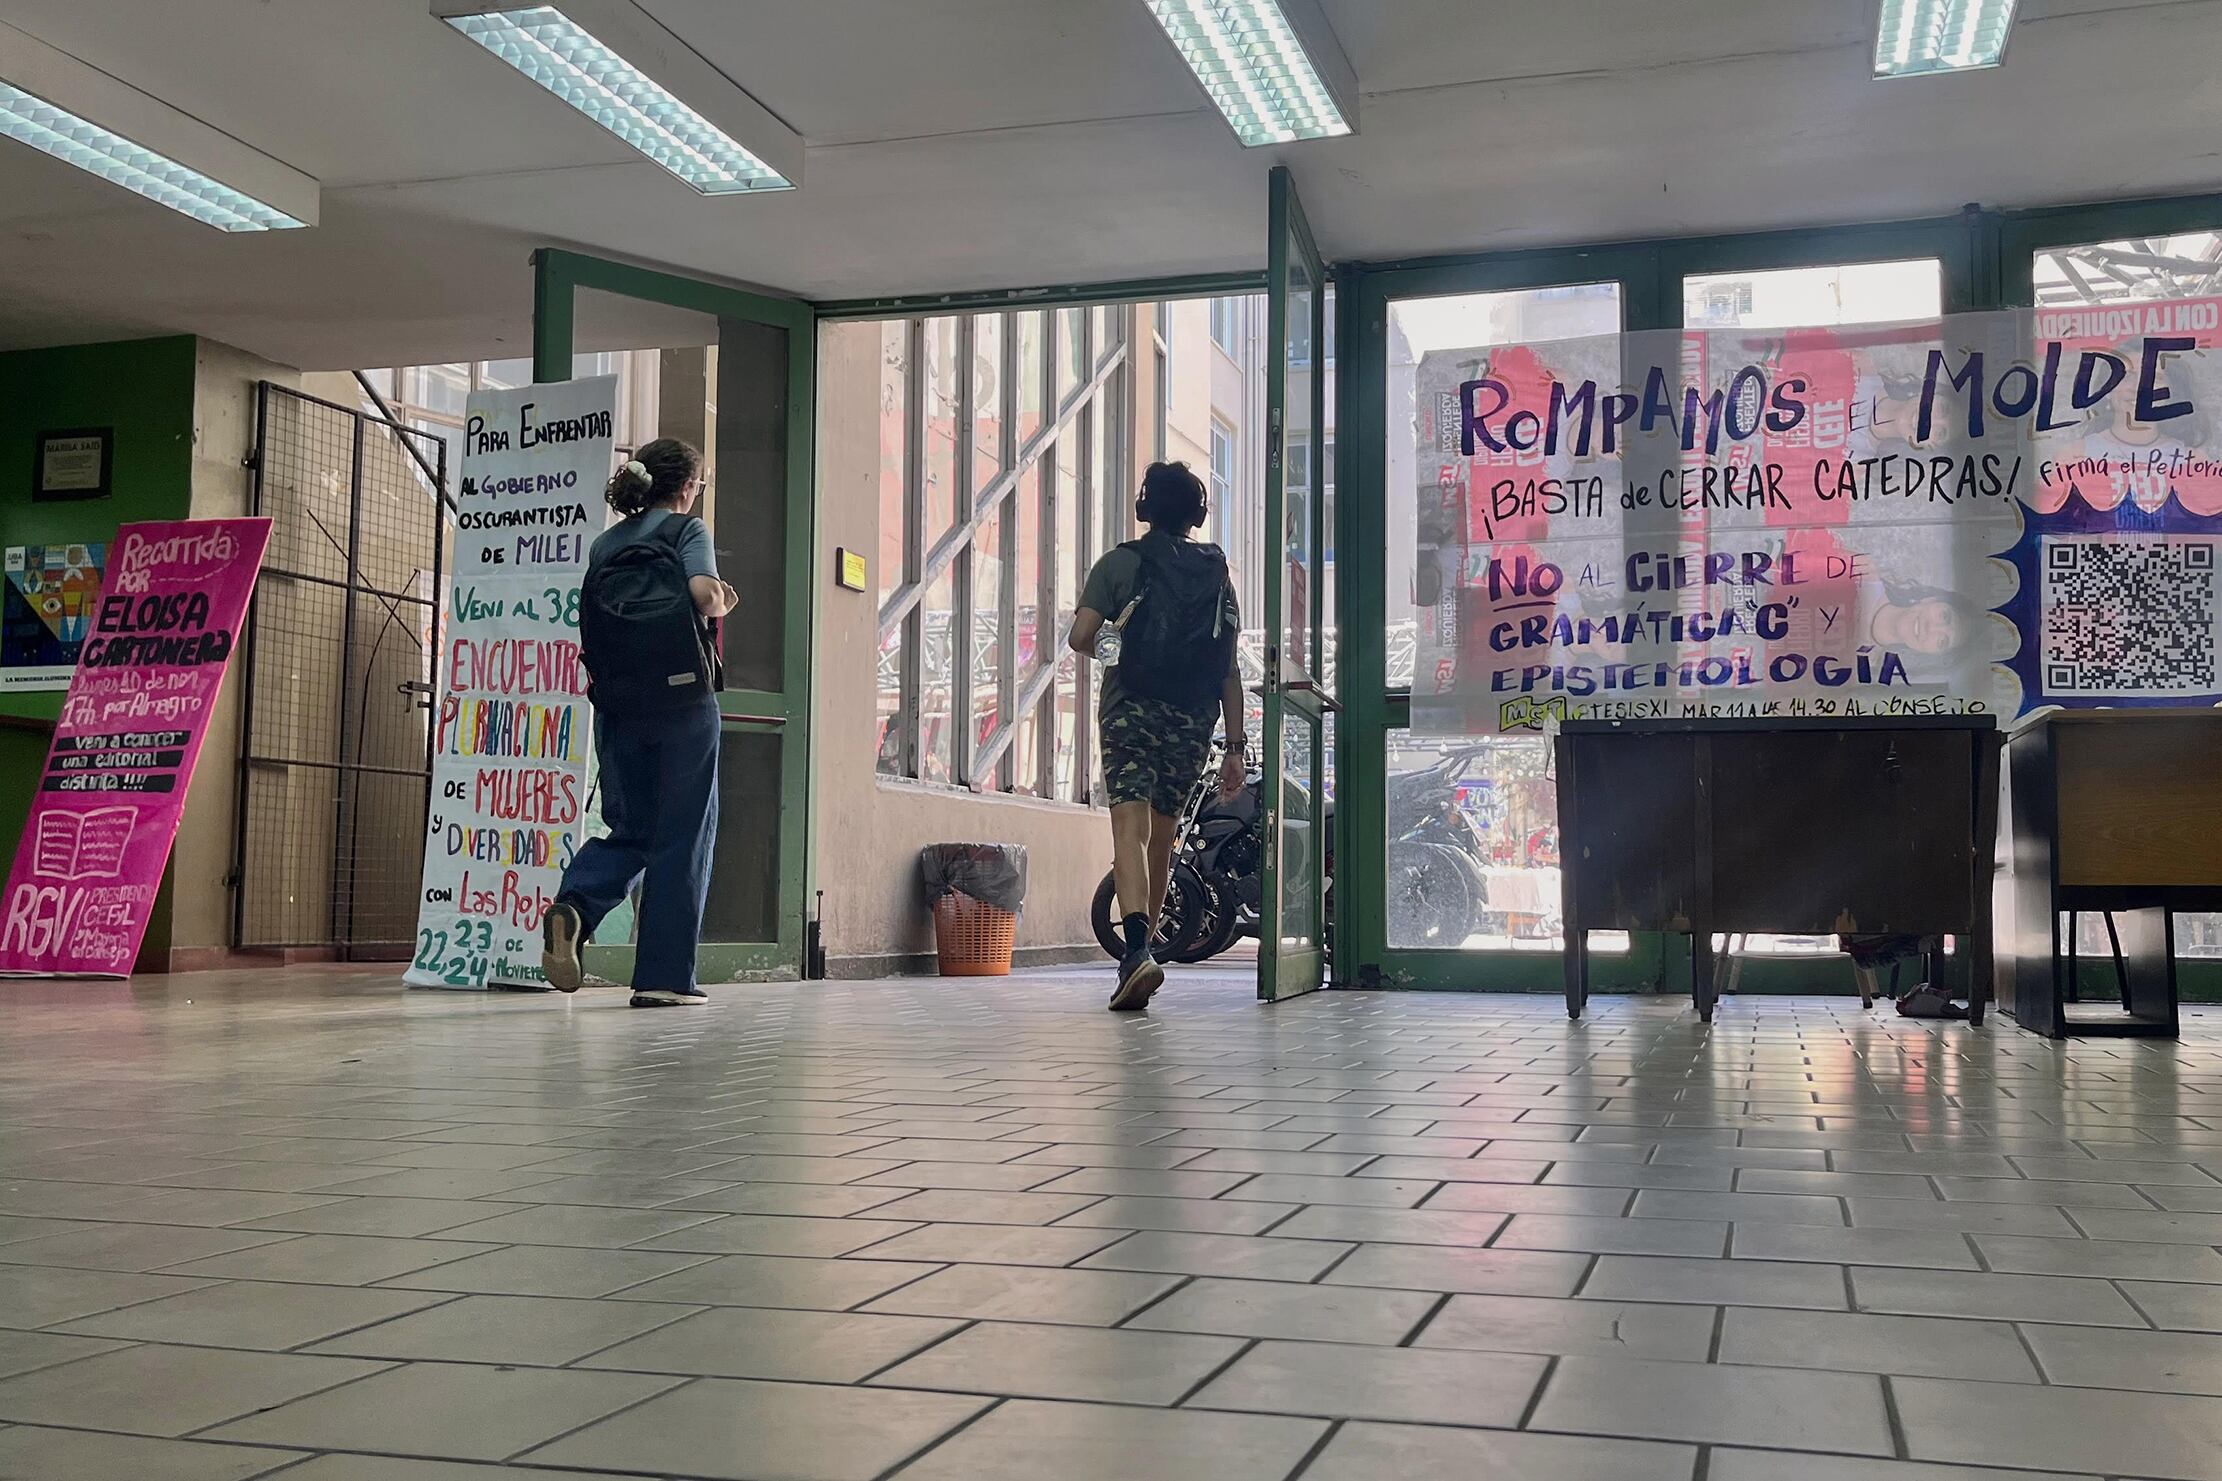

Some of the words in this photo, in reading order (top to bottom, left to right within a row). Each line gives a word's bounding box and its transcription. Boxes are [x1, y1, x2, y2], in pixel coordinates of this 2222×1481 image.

[1848, 395, 1893, 431] EL
[1916, 337, 2196, 442] MOLDE
[467, 415, 509, 457] PARA
[520, 403, 612, 449] ENFRENTAR
[2120, 451, 2135, 474] el
[460, 477, 479, 497] AL
[1483, 476, 1603, 540] ¡BASTA
[1620, 480, 1652, 512] de
[1659, 460, 1792, 513] CERRAR
[1813, 451, 2022, 504] CÁTEDRAS!
[458, 503, 587, 530] OSCURANTISTA
[481, 547, 505, 564] DE
[516, 533, 582, 565] MILEI
[115, 569, 152, 593] POR
[1489, 556, 1564, 601] NO
[1579, 563, 1616, 587] AL
[1826, 552, 1871, 583] DE
[97, 591, 209, 633] ELOISA
[512, 599, 540, 621] AL
[1489, 602, 1748, 653] GRAMÁTICA
[1819, 607, 1839, 634] Y
[145, 669, 166, 690] de
[1491, 644, 1911, 696] EPISTEMOLOGÍA
[103, 700, 131, 721] por
[128, 692, 202, 721] Almagro
[1682, 703, 1722, 720] MAR
[1845, 698, 1867, 716] AL
[110, 735, 120, 748] a
[62, 756, 88, 769] una
[95, 752, 157, 768] editorial
[444, 780, 466, 799] DE
[475, 768, 577, 824] MUJERES
[447, 823, 575, 871] DIVERSIDADES
[426, 887, 452, 902] CON
[444, 957, 488, 986] 24
[505, 938, 523, 952] DE
